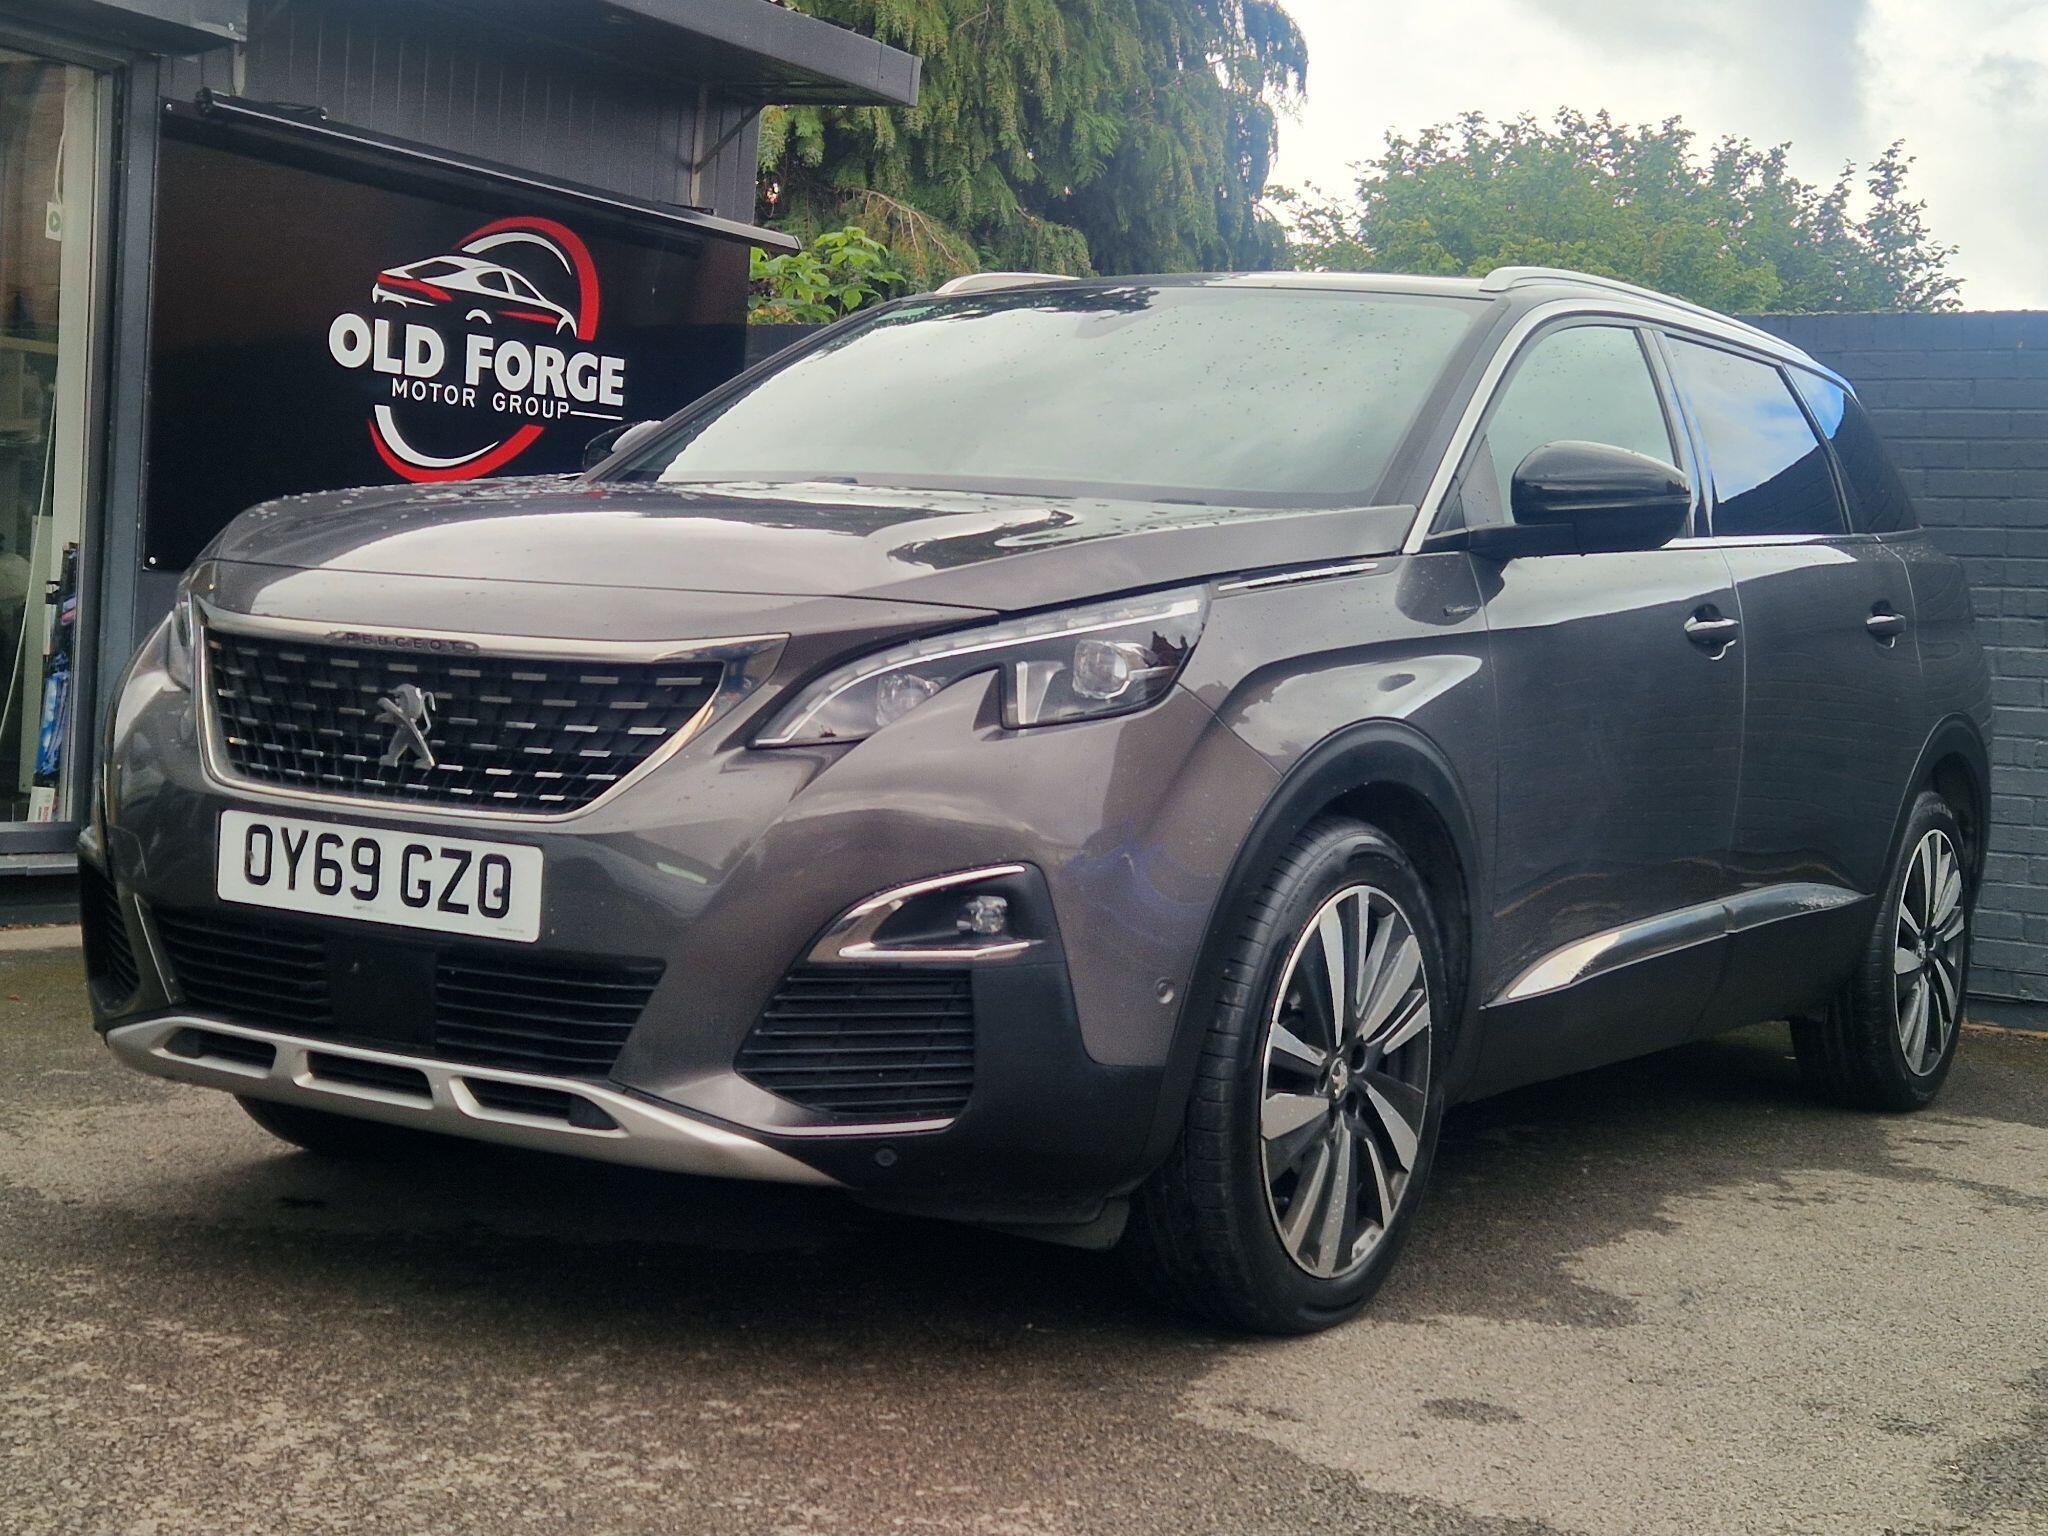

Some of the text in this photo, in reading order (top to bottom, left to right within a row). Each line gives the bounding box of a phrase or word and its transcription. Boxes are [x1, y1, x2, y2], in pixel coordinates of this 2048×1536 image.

[328, 313, 625, 406] OLD FORGE
[391, 378, 570, 419] MOTOR GROUP
[345, 632, 460, 650] PEUGEOT
[244, 823, 512, 919] OY69 GZO
